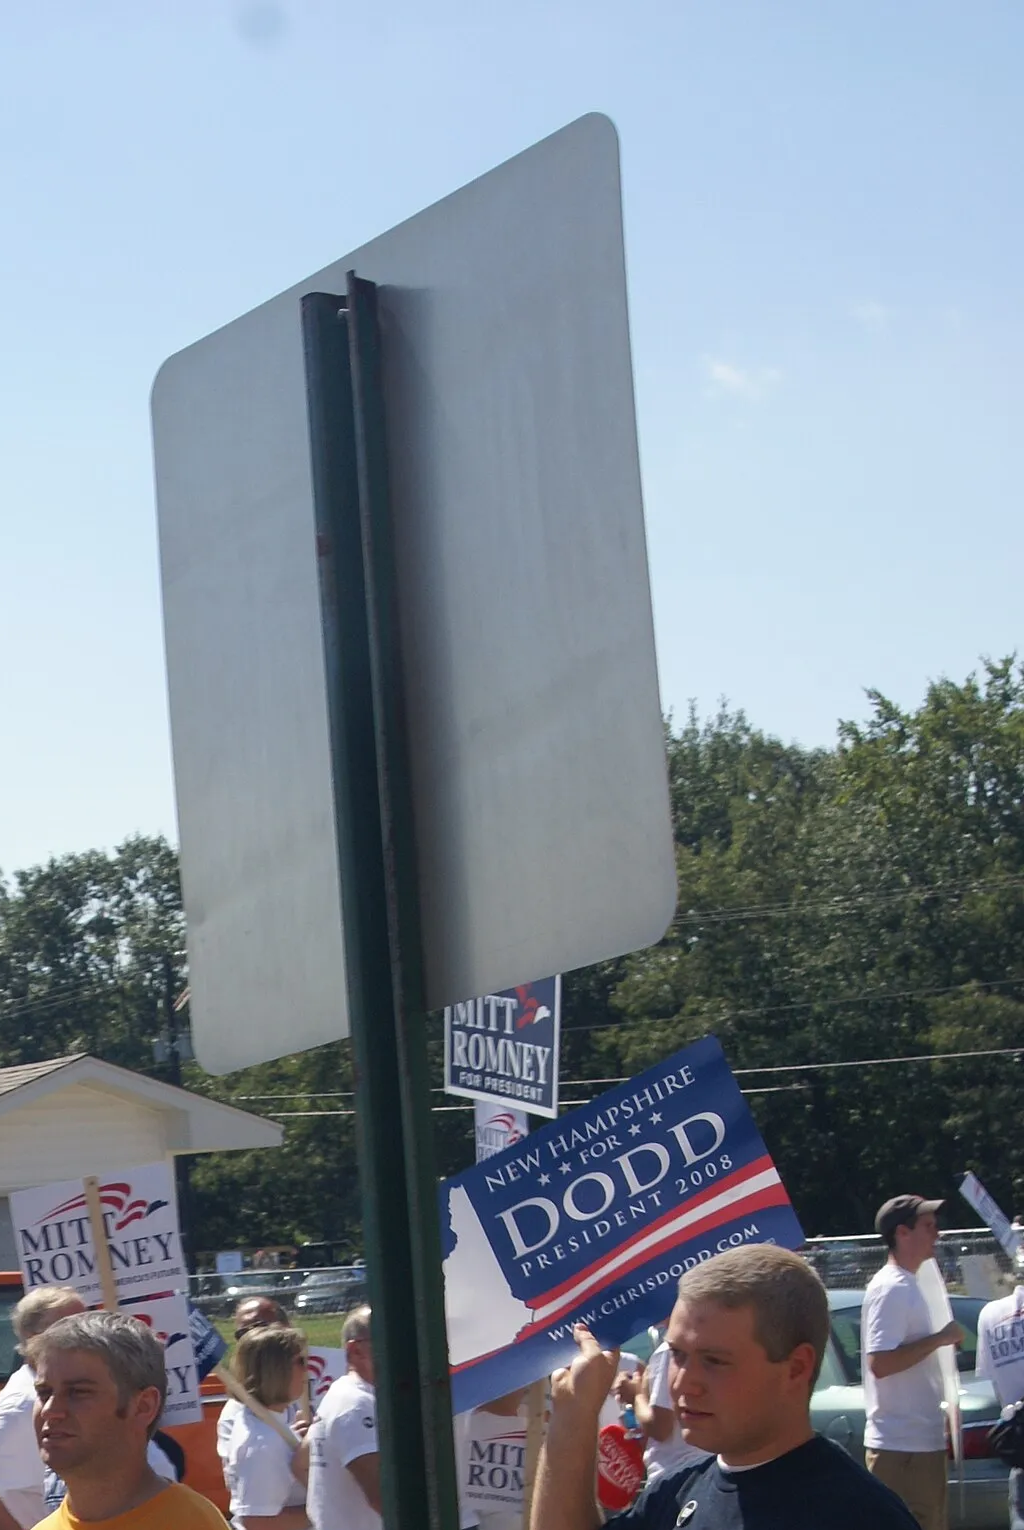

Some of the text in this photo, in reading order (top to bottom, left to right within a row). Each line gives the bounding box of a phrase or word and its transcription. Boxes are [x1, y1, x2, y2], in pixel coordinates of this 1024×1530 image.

[452, 994, 519, 1035] MITT
[452, 1030, 552, 1085] ROMNEY
[458, 1071, 544, 1102] FOR PRESIDENT
[484, 1065, 696, 1193] NEW HAMPSHIRE
[579, 1134, 622, 1165] FOR
[494, 1111, 726, 1261] DODD
[19, 1210, 116, 1256] MITT
[520, 1153, 733, 1278] PRESIDENT 2008
[24, 1231, 176, 1288] ROMNEY
[469, 1440, 525, 1468] MIT
[467, 1464, 525, 1492] ROM
